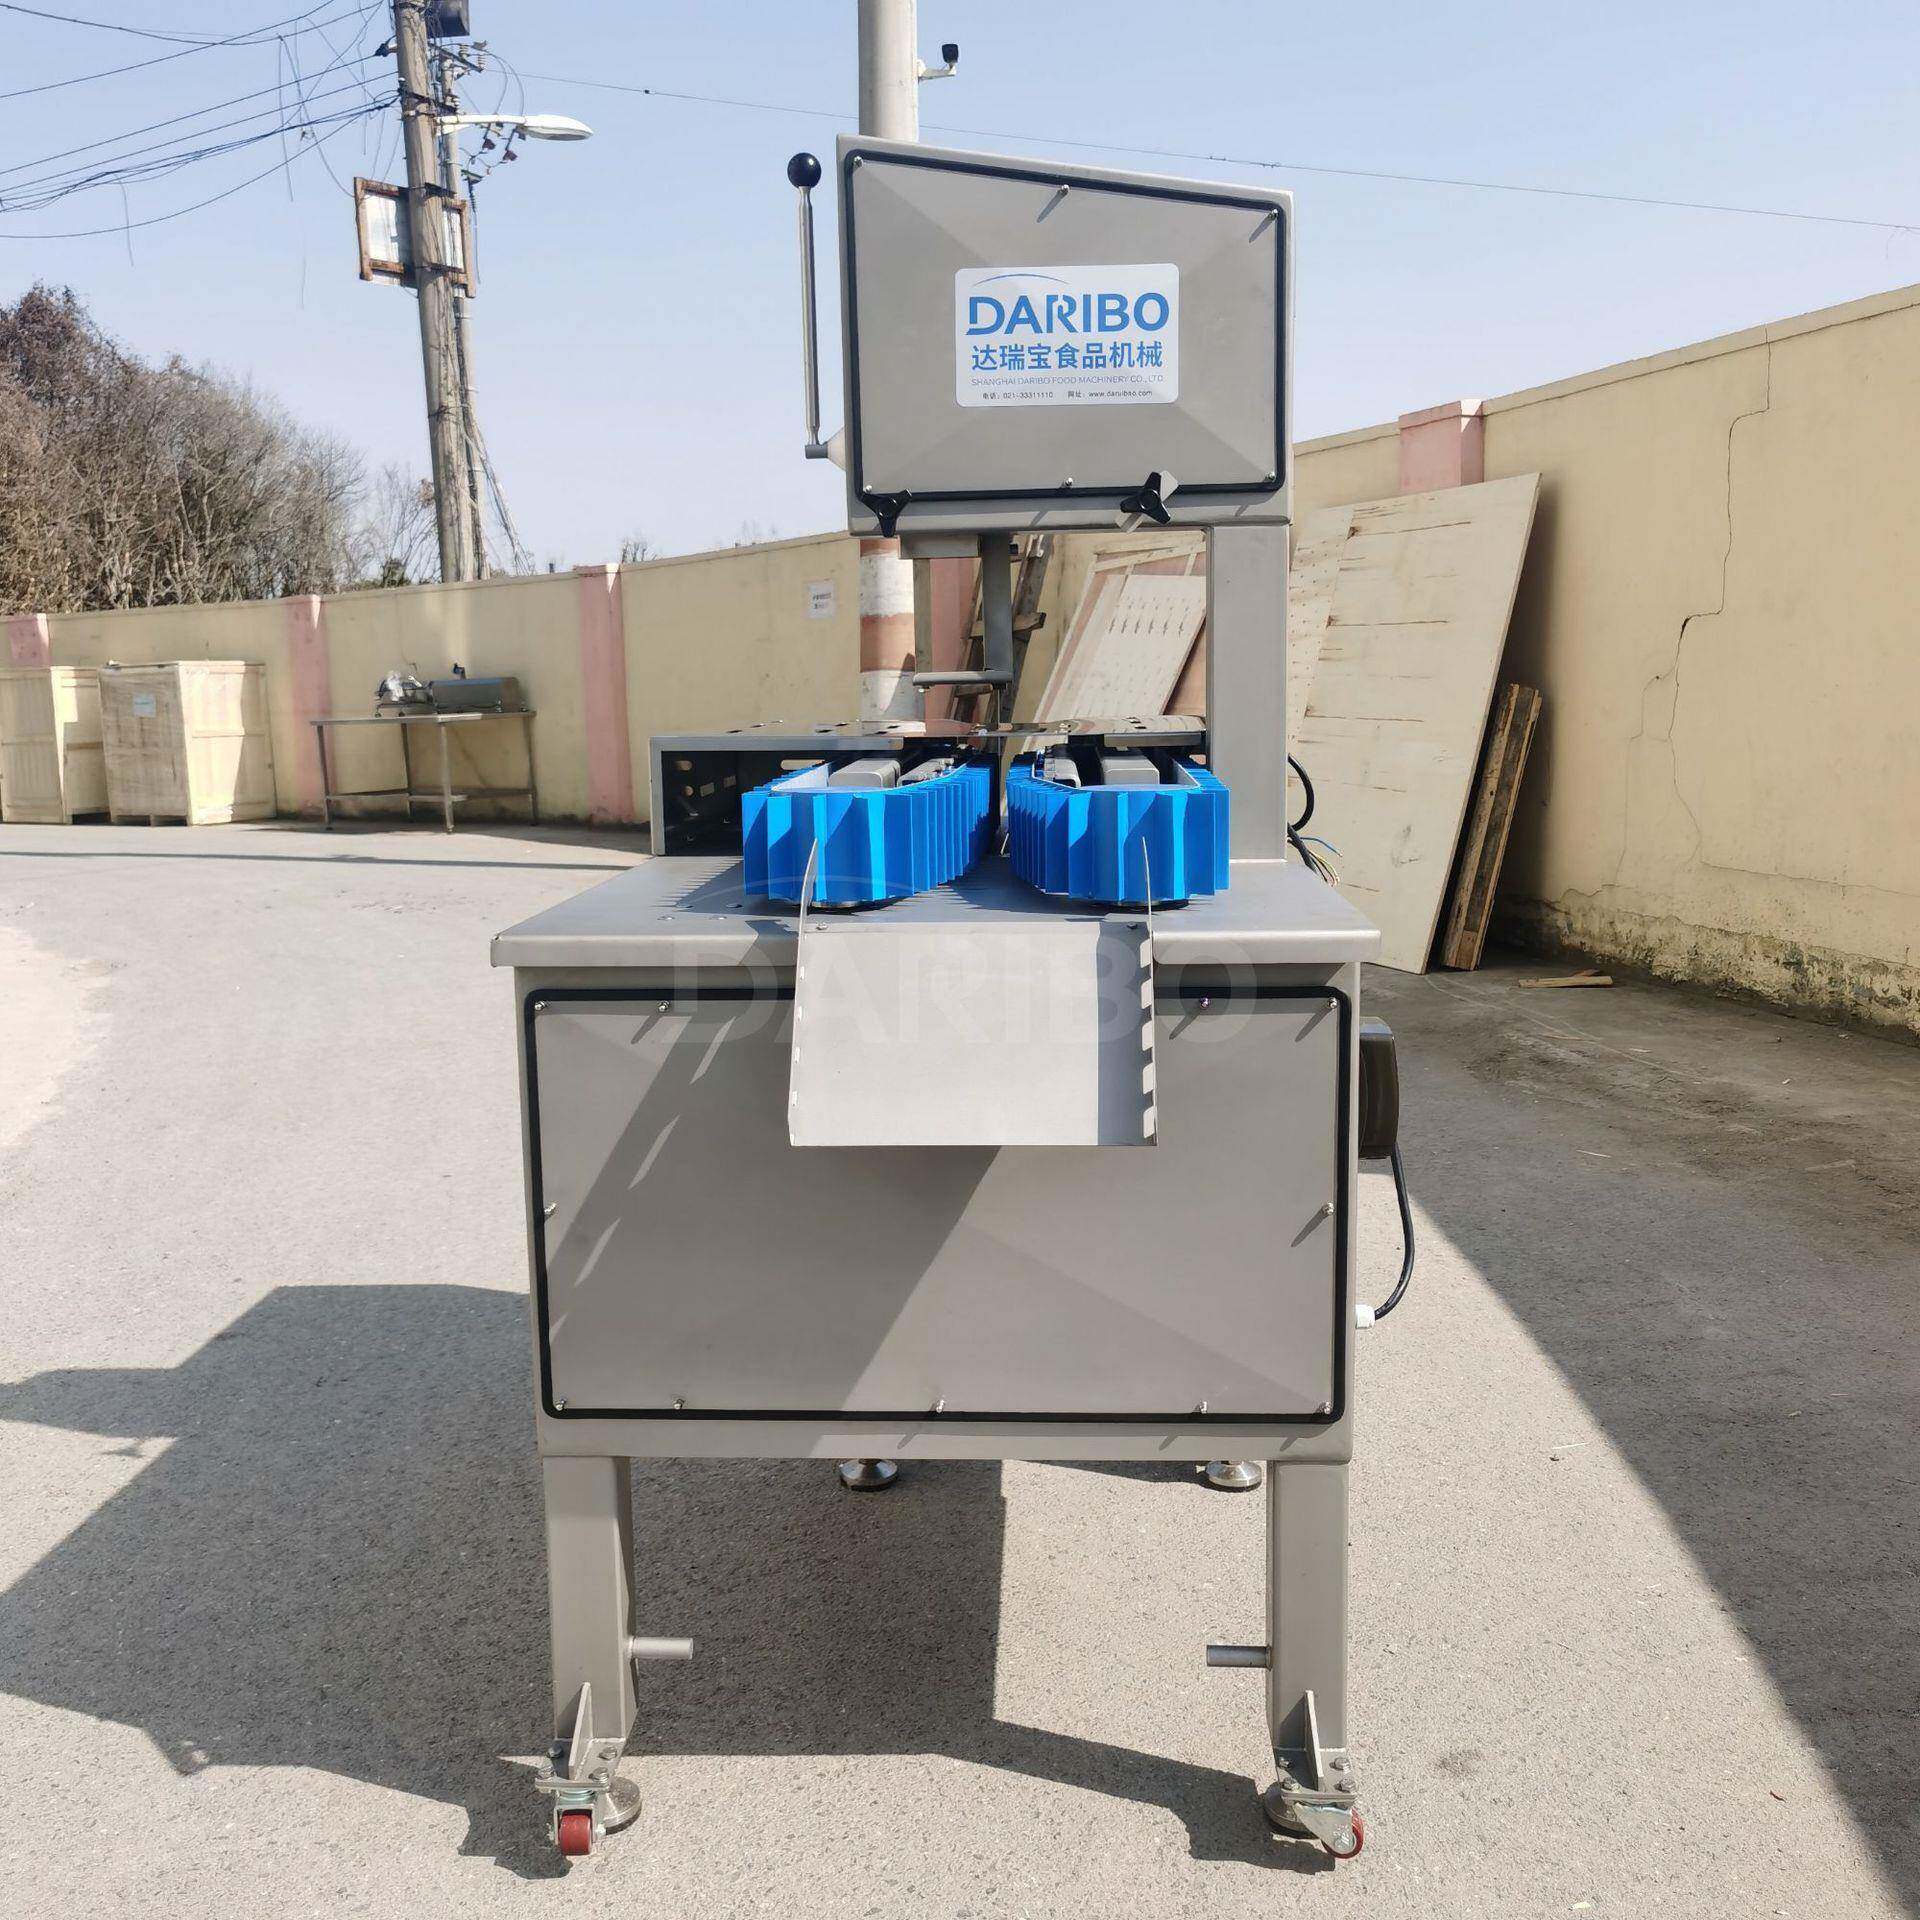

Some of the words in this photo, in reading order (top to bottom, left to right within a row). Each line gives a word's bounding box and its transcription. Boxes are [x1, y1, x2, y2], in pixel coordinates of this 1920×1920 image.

[965, 292, 1170, 336] DARIBO
[971, 341, 1163, 371] 达瑞宝食品机械
[971, 377, 1016, 387] SHANGHAI
[1018, 376, 1051, 385] DARIBO
[1053, 376, 1077, 385] FOOD
[1079, 375, 1128, 384] MACHINERY
